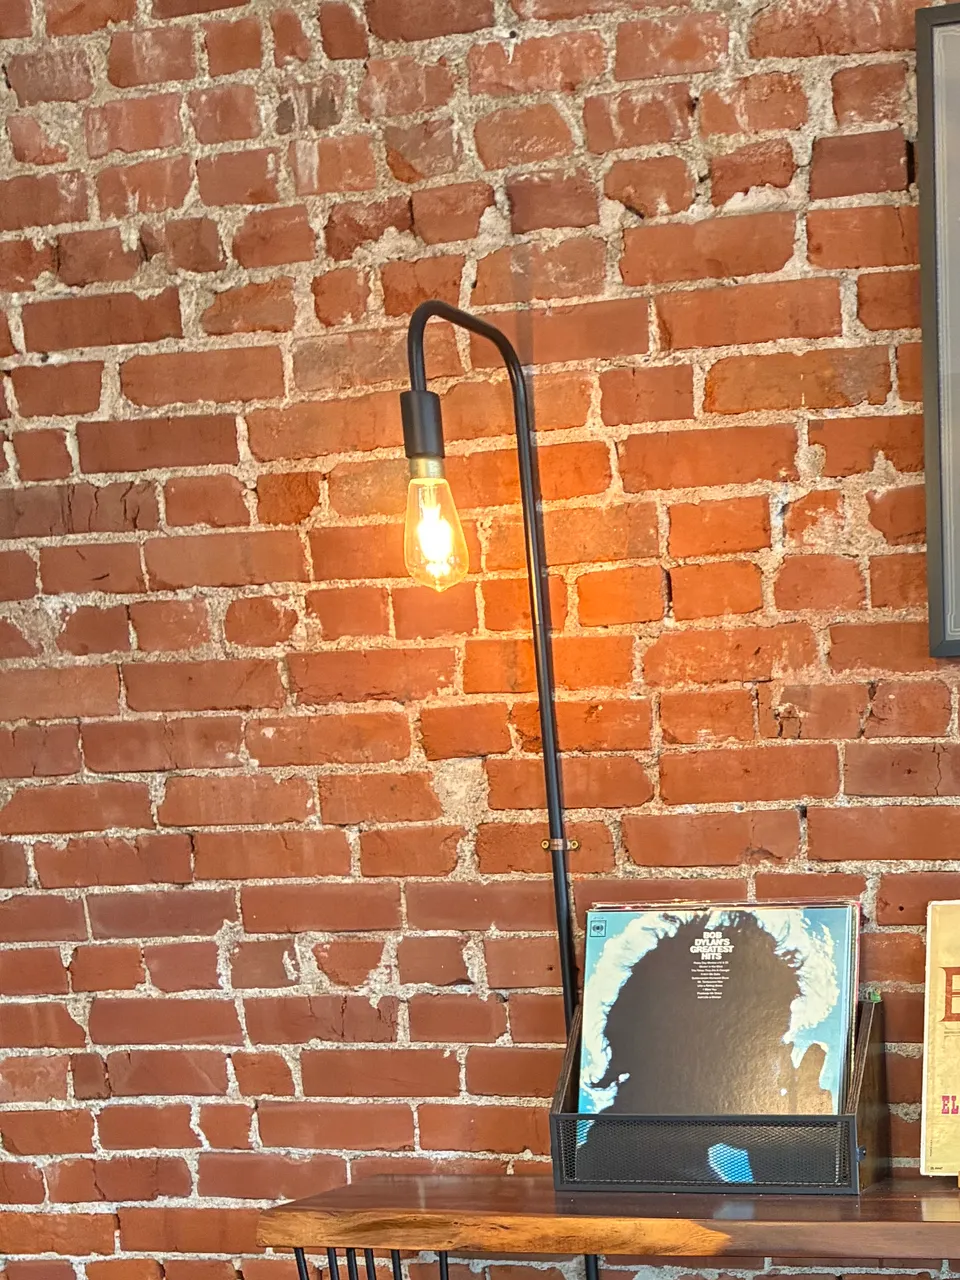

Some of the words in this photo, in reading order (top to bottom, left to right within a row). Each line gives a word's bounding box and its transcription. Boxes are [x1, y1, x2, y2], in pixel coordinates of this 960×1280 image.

[702, 931, 723, 939] BOB
[694, 938, 731, 946] DYLAN'S
[689, 945, 735, 953] GREATEST
[700, 952, 723, 960] HITS
